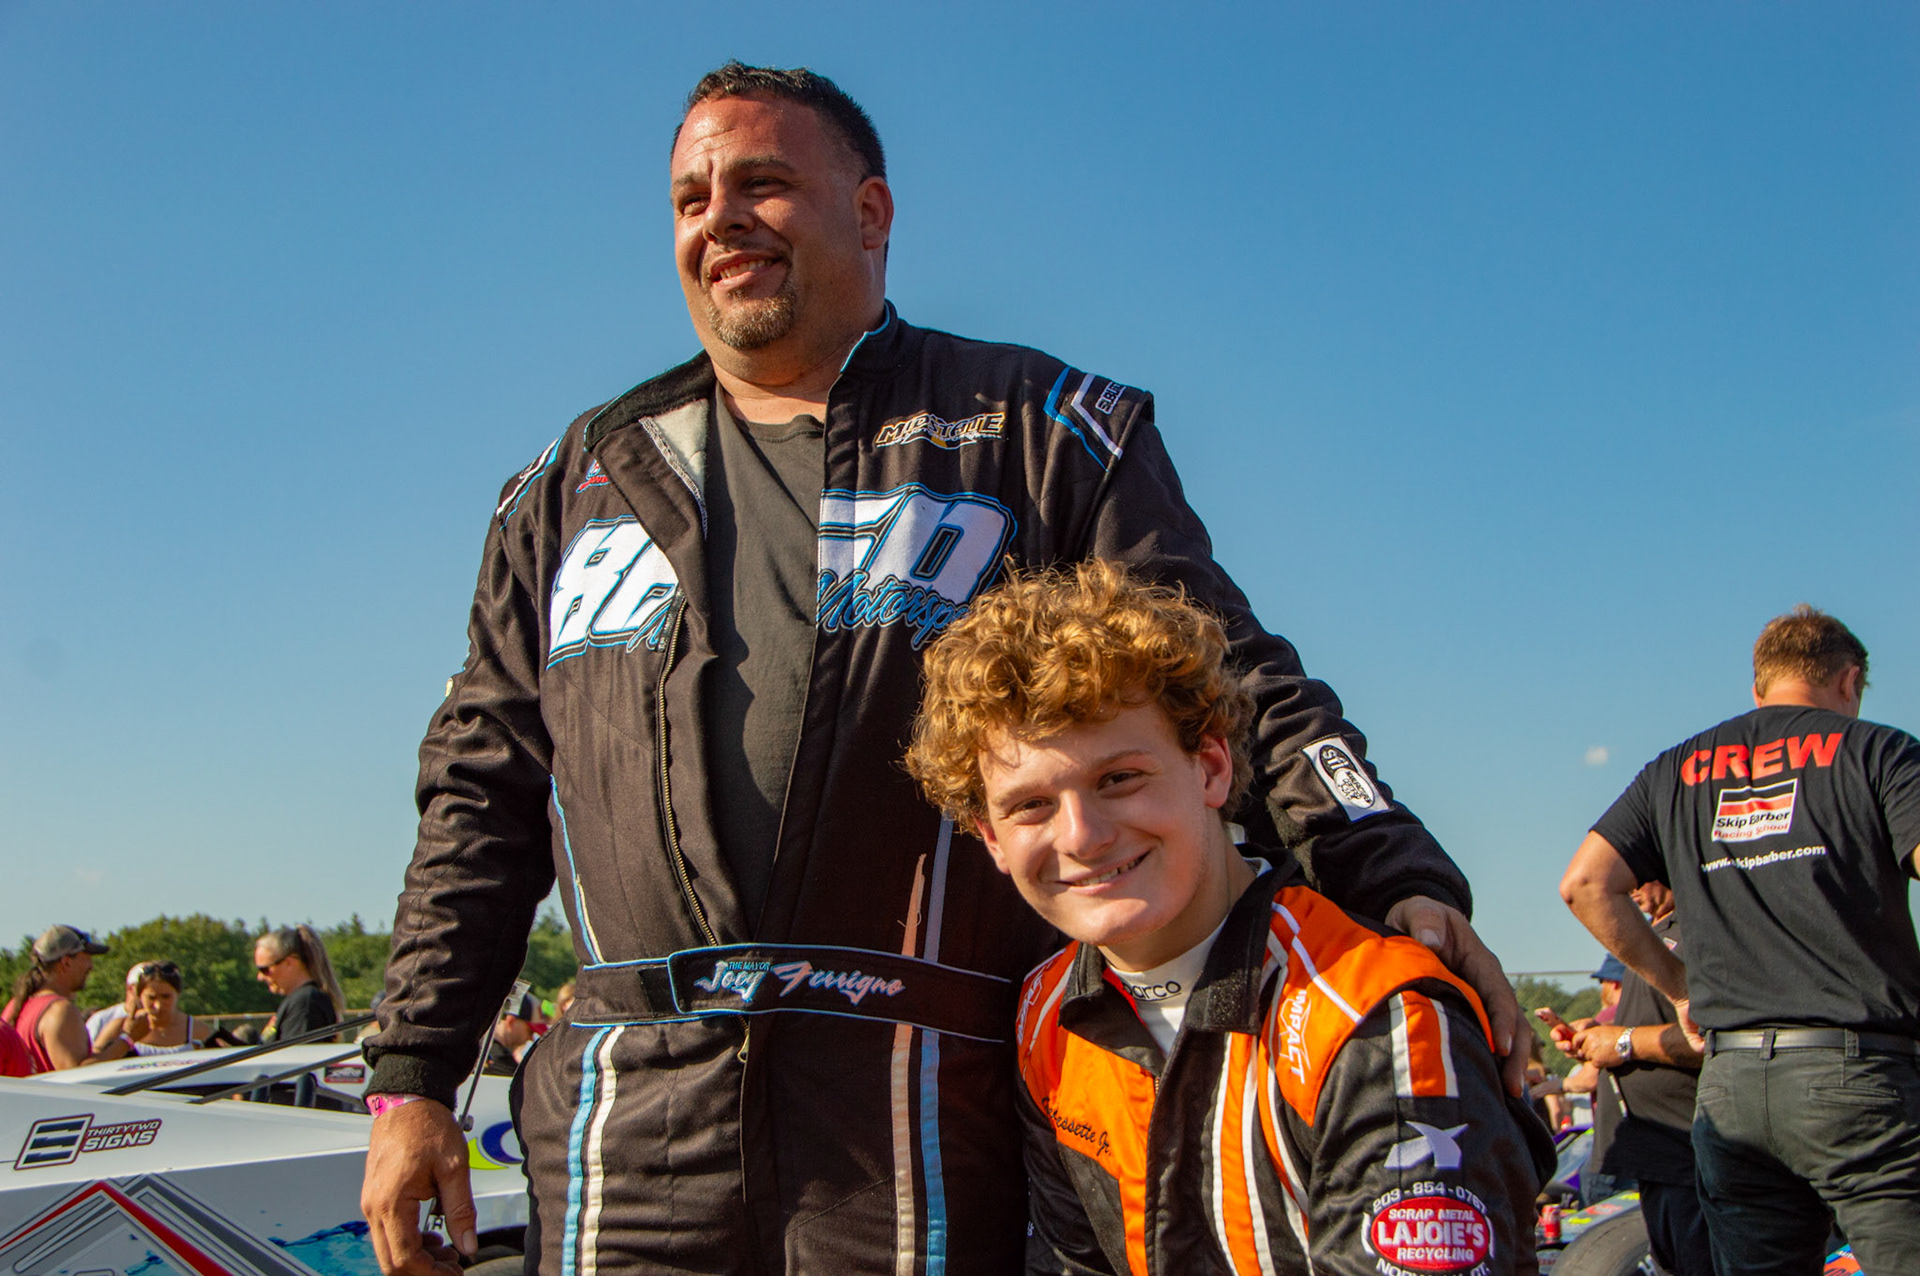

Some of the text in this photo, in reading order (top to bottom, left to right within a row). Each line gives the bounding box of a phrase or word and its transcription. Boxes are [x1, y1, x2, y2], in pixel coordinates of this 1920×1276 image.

[1681, 733, 1843, 786] CREW
[1716, 811, 1790, 829] Skip Barber
[1713, 830, 1753, 839] Racing
[728, 961, 770, 971] THE MAYOR
[694, 960, 766, 1002] Joey
[1287, 989, 1308, 1085] IMPACT
[87, 1121, 160, 1138] THIRTYTWO
[82, 1130, 156, 1151] SIGNS
[1388, 1208, 1476, 1221] SCRAP METAL
[1377, 1220, 1486, 1248] LAJOIE'S
[1396, 1247, 1475, 1261] RECYCLING
